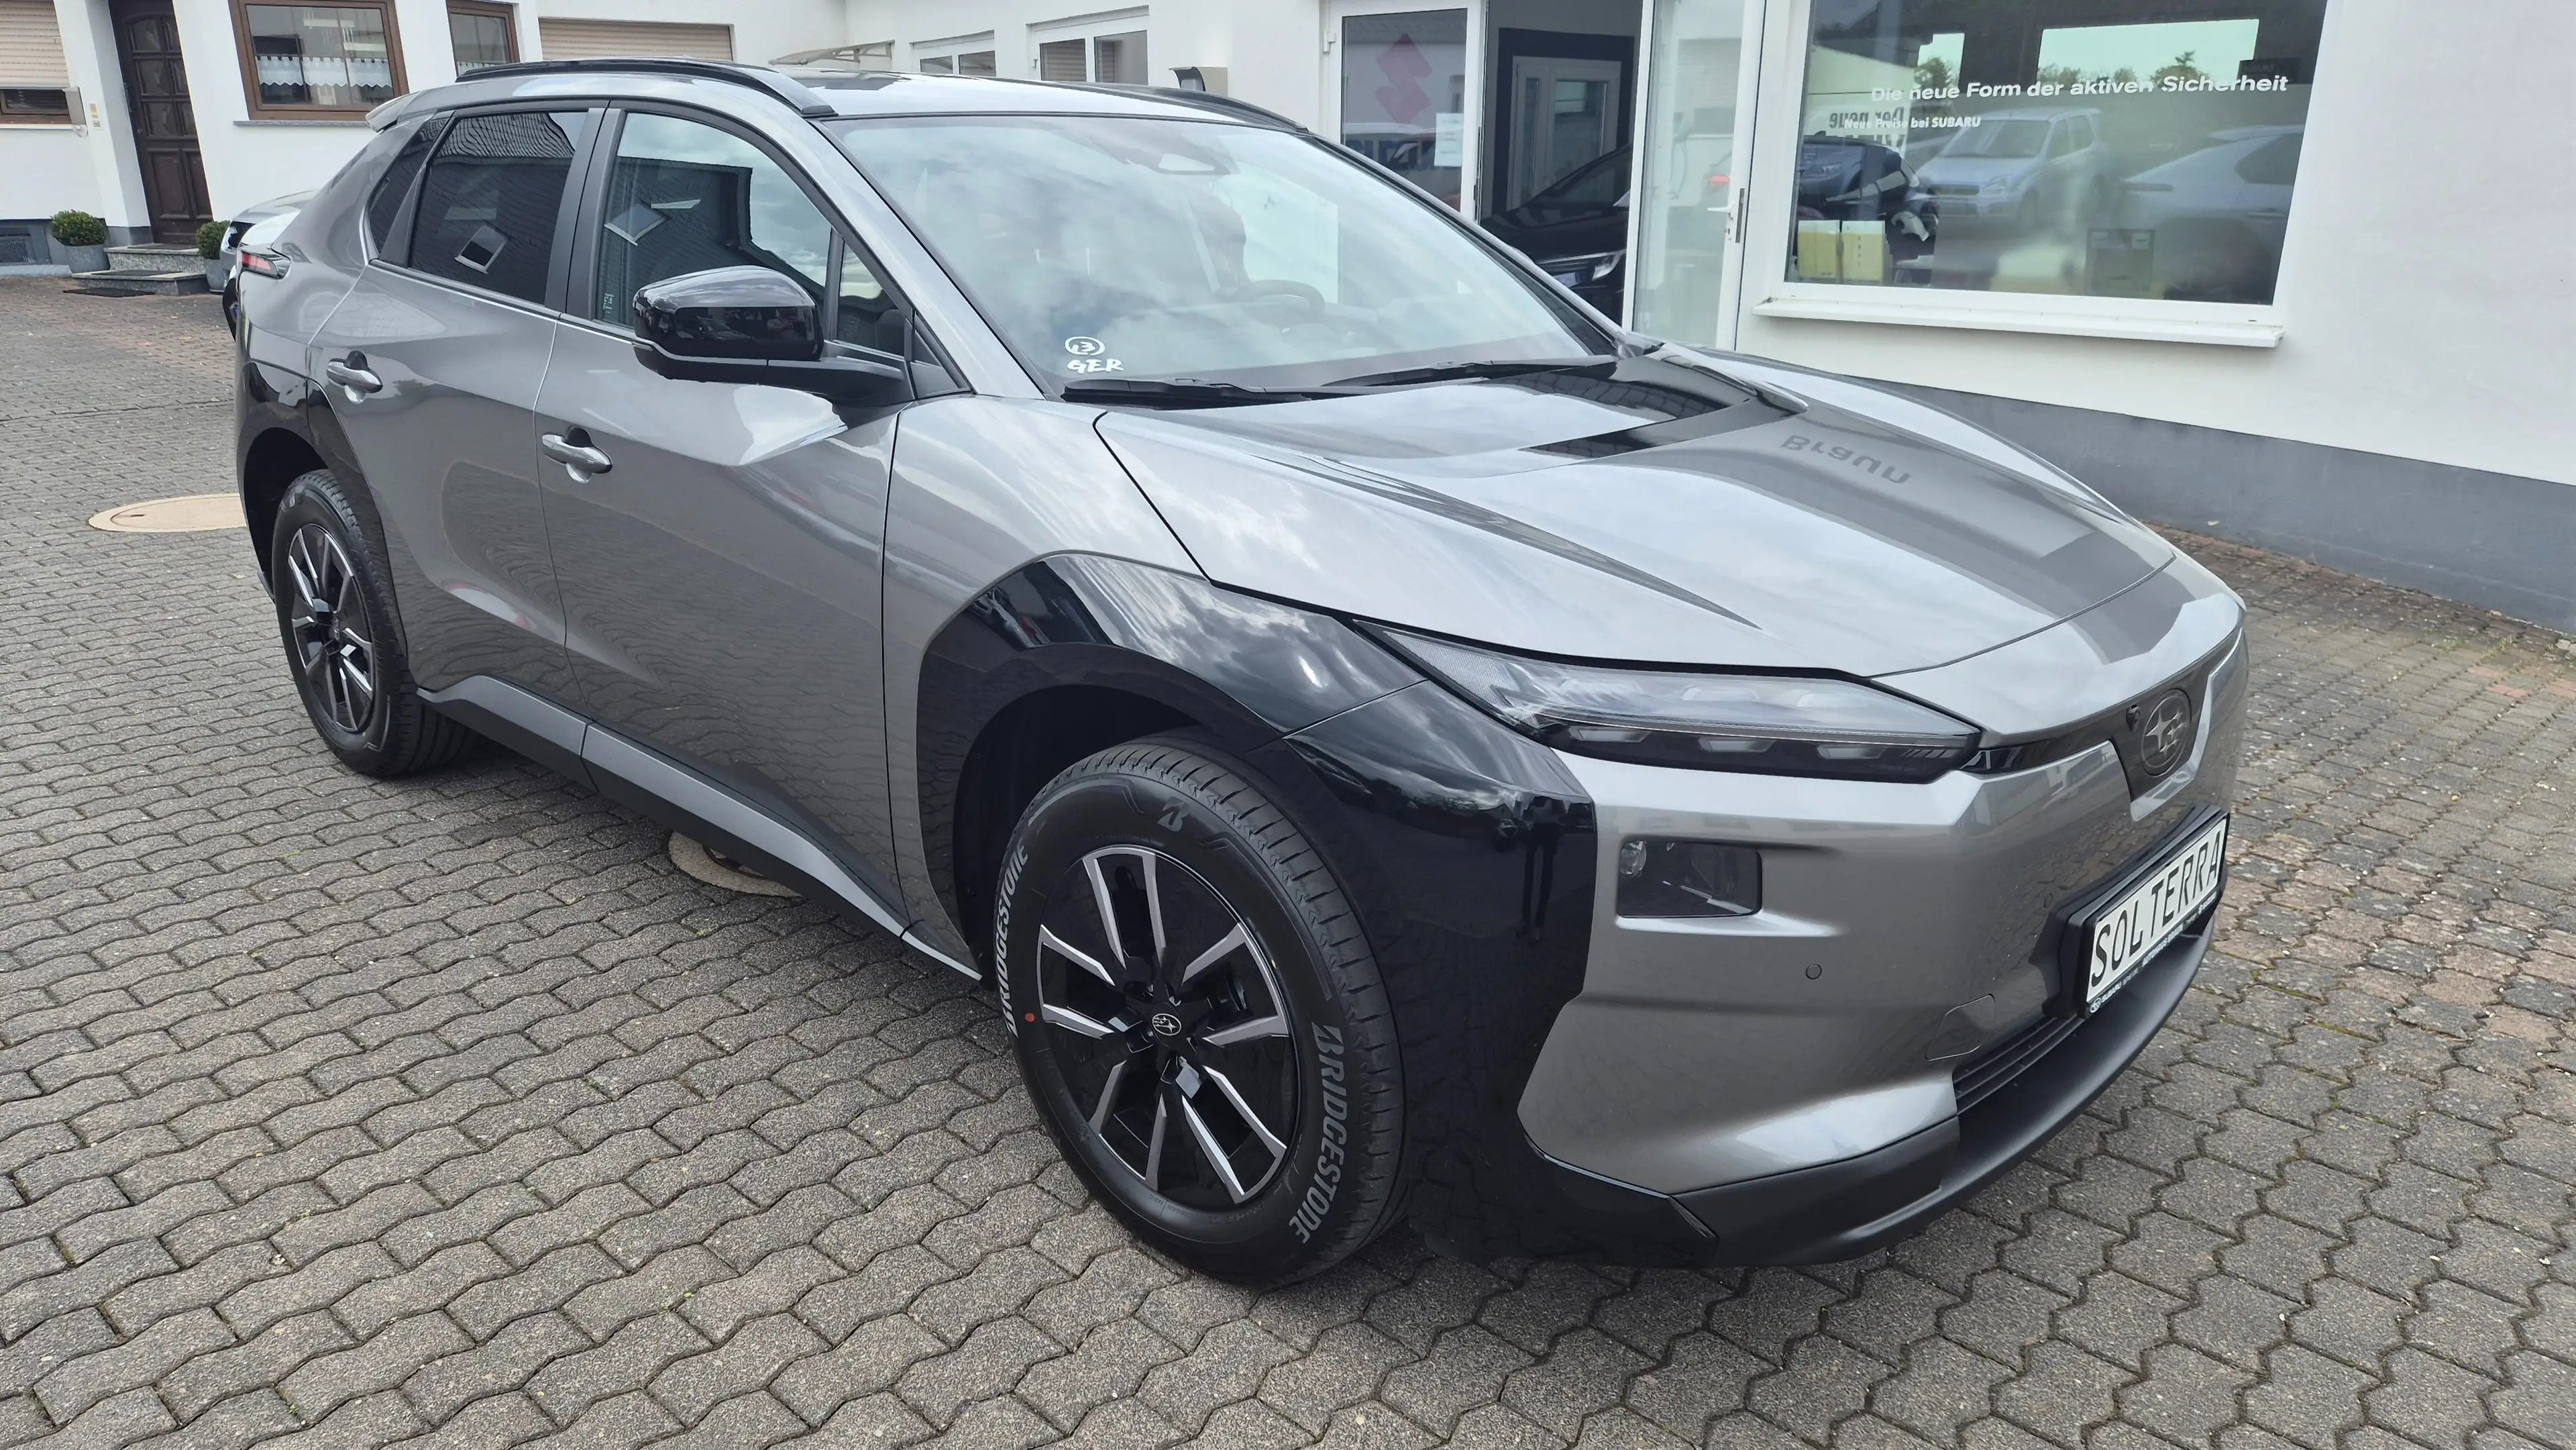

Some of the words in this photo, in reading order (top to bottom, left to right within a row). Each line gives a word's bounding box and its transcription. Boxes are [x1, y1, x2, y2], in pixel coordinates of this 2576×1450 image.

[1844, 117, 1872, 130] Neue
[1876, 117, 1908, 130] Preise
[1911, 116, 1930, 128] bei
[1931, 115, 1982, 128] SUBARU
[1870, 87, 1902, 102] Die
[1909, 87, 1960, 100] neue
[1966, 82, 2021, 98] Form
[2027, 81, 2064, 97] der
[2070, 79, 2154, 95] aktiven
[2161, 75, 2289, 92] Sicherheit
[1067, 358, 1124, 374] GER
[996, 843, 1028, 1038] BRIDGESTONE
[2091, 829, 2221, 988] SOLTERRA
[1289, 1021, 1348, 1244] BRIDGESTONE
